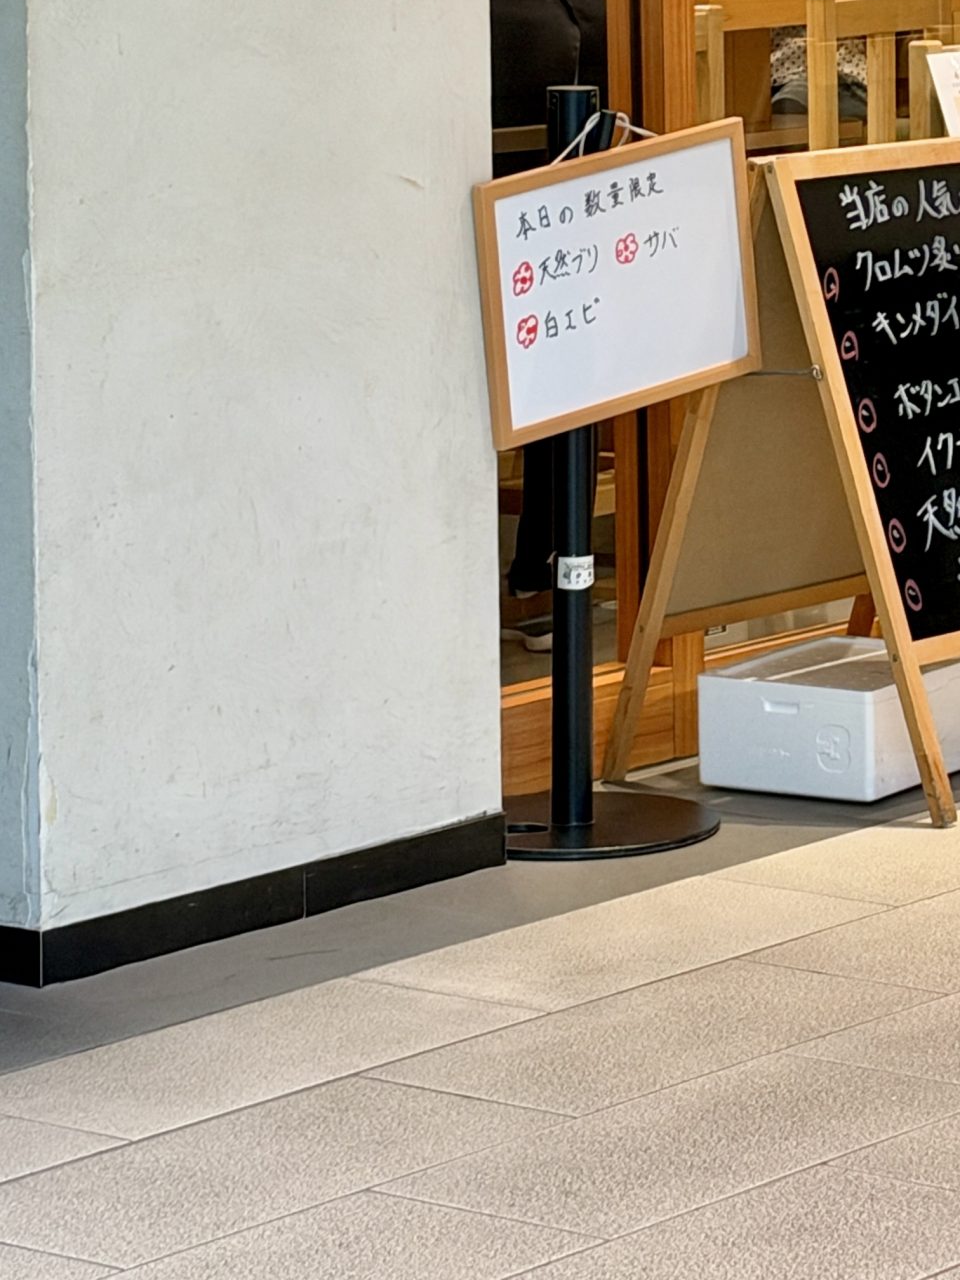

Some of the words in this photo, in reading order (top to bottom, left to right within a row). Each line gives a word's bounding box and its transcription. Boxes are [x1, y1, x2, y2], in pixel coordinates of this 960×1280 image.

[515, 172, 664, 241] 本日の数量限定
[538, 244, 599, 287] 天然ブリ
[643, 226, 681, 258] サバ
[871, 291, 960, 346] キンメダイ
